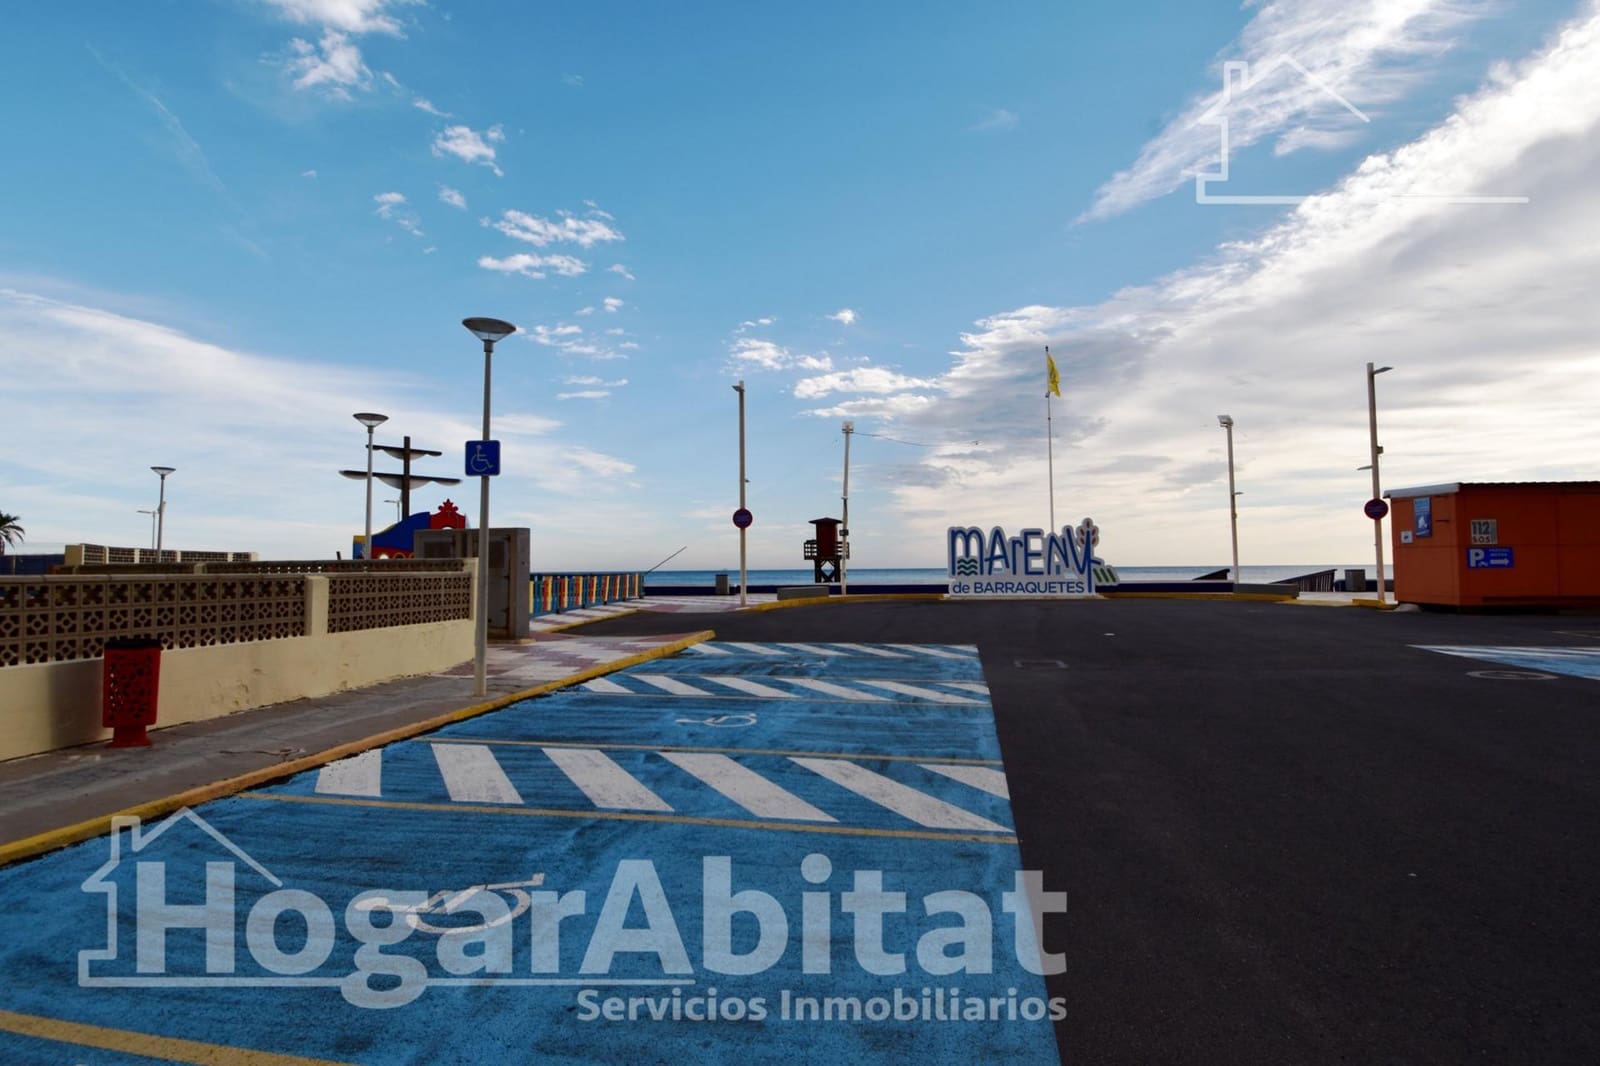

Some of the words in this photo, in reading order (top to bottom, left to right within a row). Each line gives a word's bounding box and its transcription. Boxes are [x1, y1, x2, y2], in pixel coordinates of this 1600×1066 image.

[1472, 521, 1490, 535] 112
[952, 581, 970, 594] de
[974, 581, 1085, 594] BARRAQUETES
